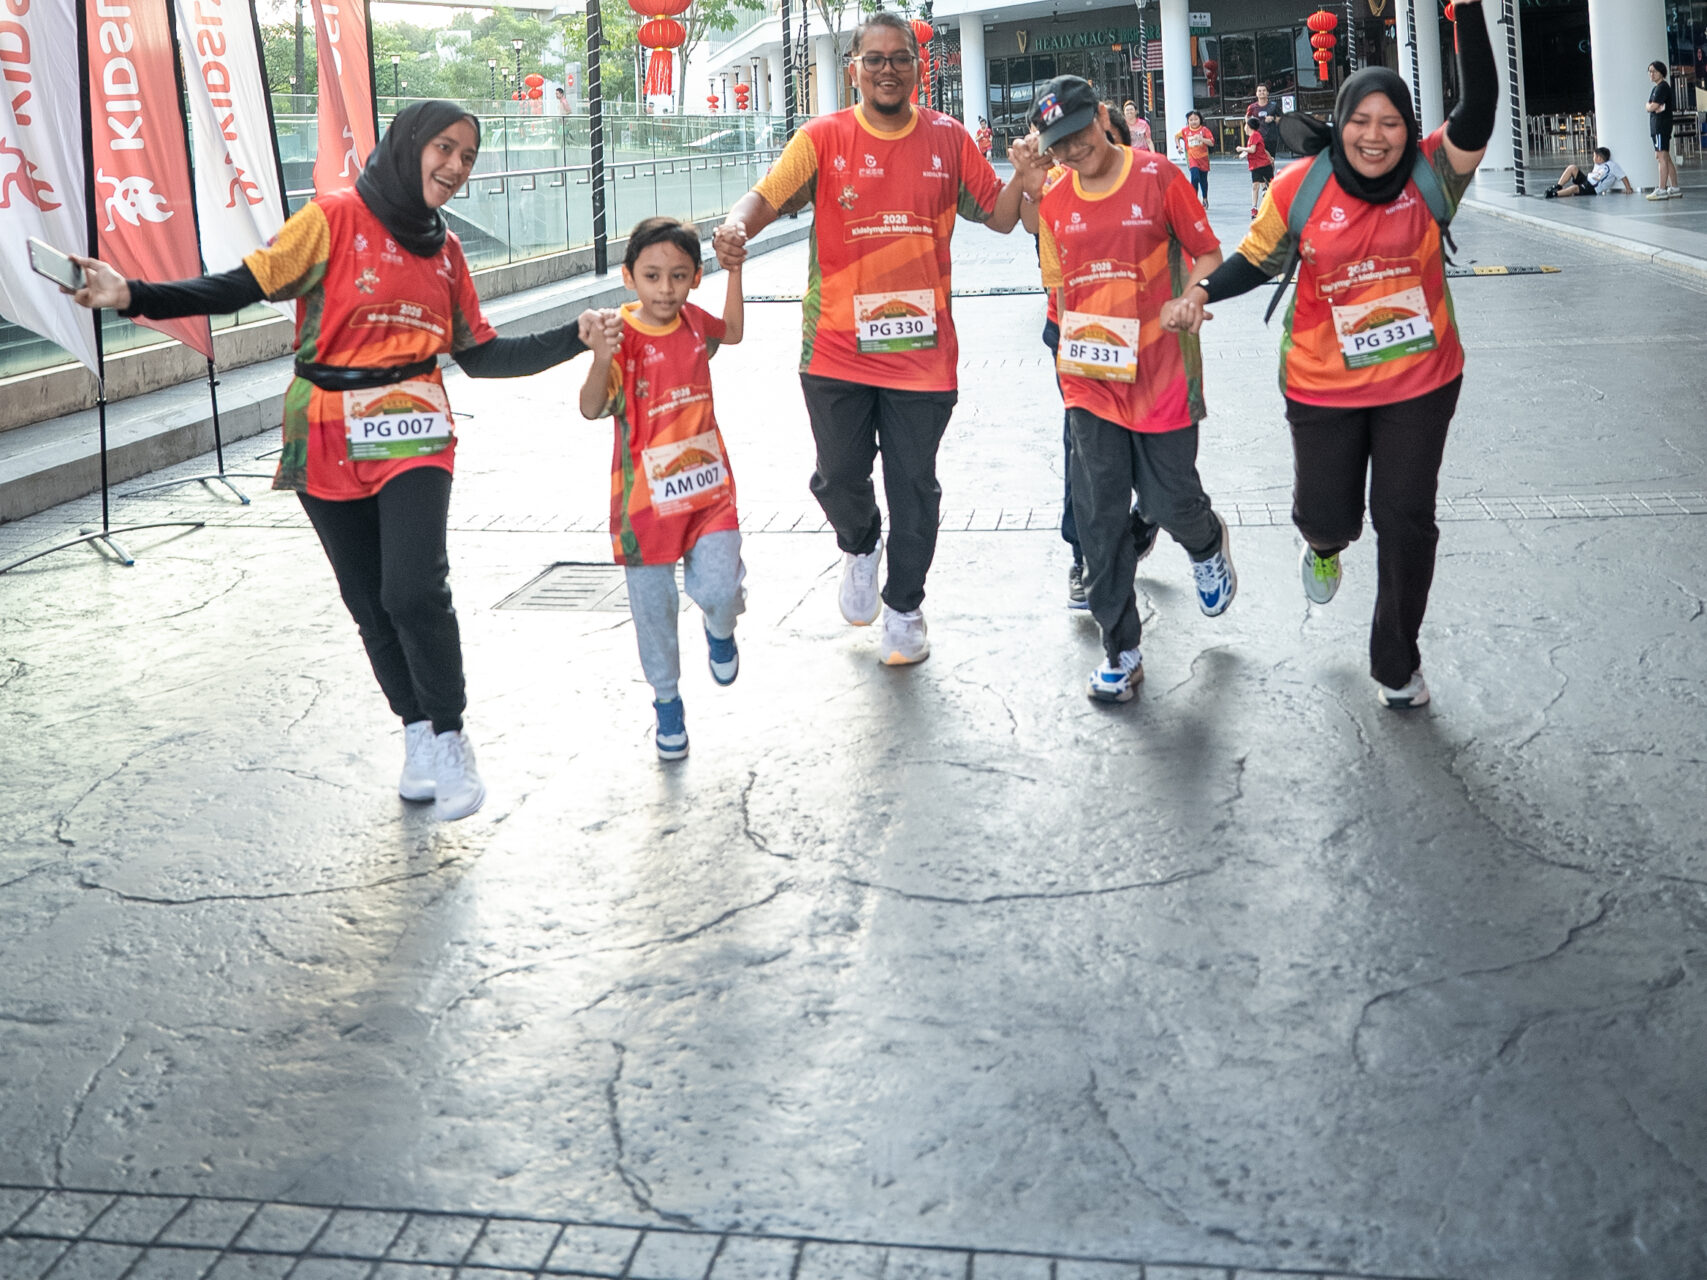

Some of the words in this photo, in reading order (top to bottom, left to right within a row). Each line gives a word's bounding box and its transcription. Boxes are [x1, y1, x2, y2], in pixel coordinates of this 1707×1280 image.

[1035, 34, 1074, 51] HEALY
[1079, 28, 1116, 47] MAC'S
[869, 322, 891, 337] PG
[895, 320, 924, 335] 330
[1354, 333, 1380, 351] PG
[1383, 322, 1415, 343] 331
[1070, 343, 1087, 358] BF
[1091, 347, 1119, 363] 331
[363, 421, 391, 438] PG
[397, 417, 435, 436] 007
[664, 476, 694, 498] AM
[696, 466, 719, 488] 007
